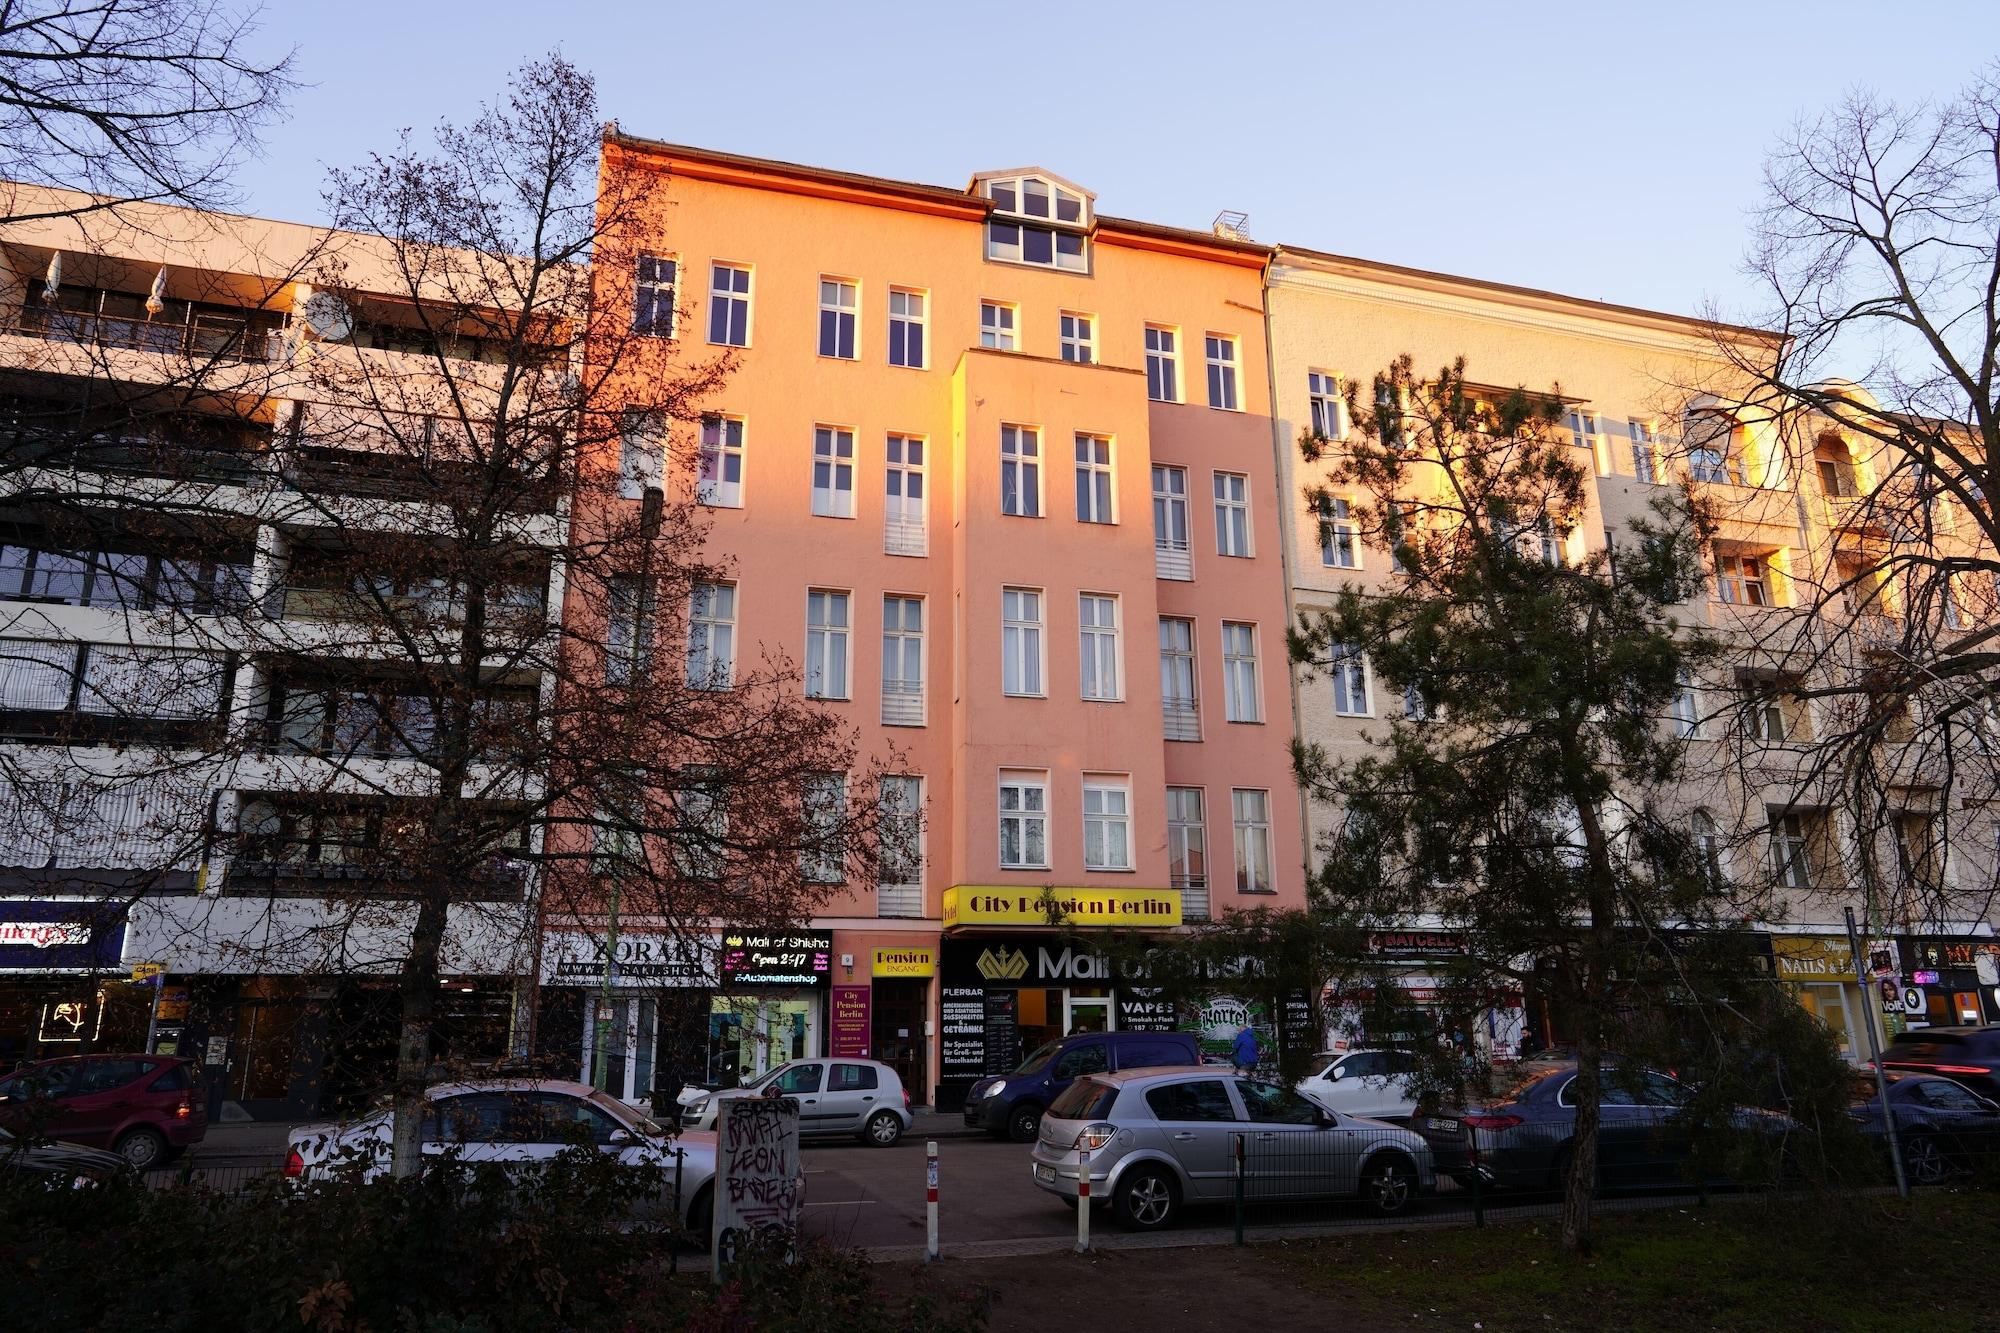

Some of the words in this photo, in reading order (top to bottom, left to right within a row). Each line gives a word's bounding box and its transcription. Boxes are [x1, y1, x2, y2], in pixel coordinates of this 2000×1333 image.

[970, 896, 1013, 914] City
[1019, 897, 1103, 914] Pension
[1108, 898, 1171, 914] Berlin
[746, 936, 769, 947] Mall
[773, 937, 787, 947] of
[789, 937, 829, 948] Shisha
[1385, 934, 1456, 947] BAYCELL
[752, 953, 778, 967] Open
[877, 952, 929, 964] Pension
[1038, 946, 1110, 979] Mall
[886, 965, 920, 973] EINGANG
[1781, 958, 1826, 974] NAILS
[1829, 963, 1838, 974] &
[844, 991, 859, 1001] City
[943, 988, 984, 997] FLERBAR
[836, 1001, 866, 1009] Pension
[1121, 1002, 1174, 1014] VAPES
[1882, 1000, 1904, 1011] Volt
[839, 1009, 864, 1018] Berlin
[943, 1040, 953, 1048] Ihr
[954, 1040, 983, 1049] Spezialist
[944, 1056, 983, 1064] Einzelhandel
